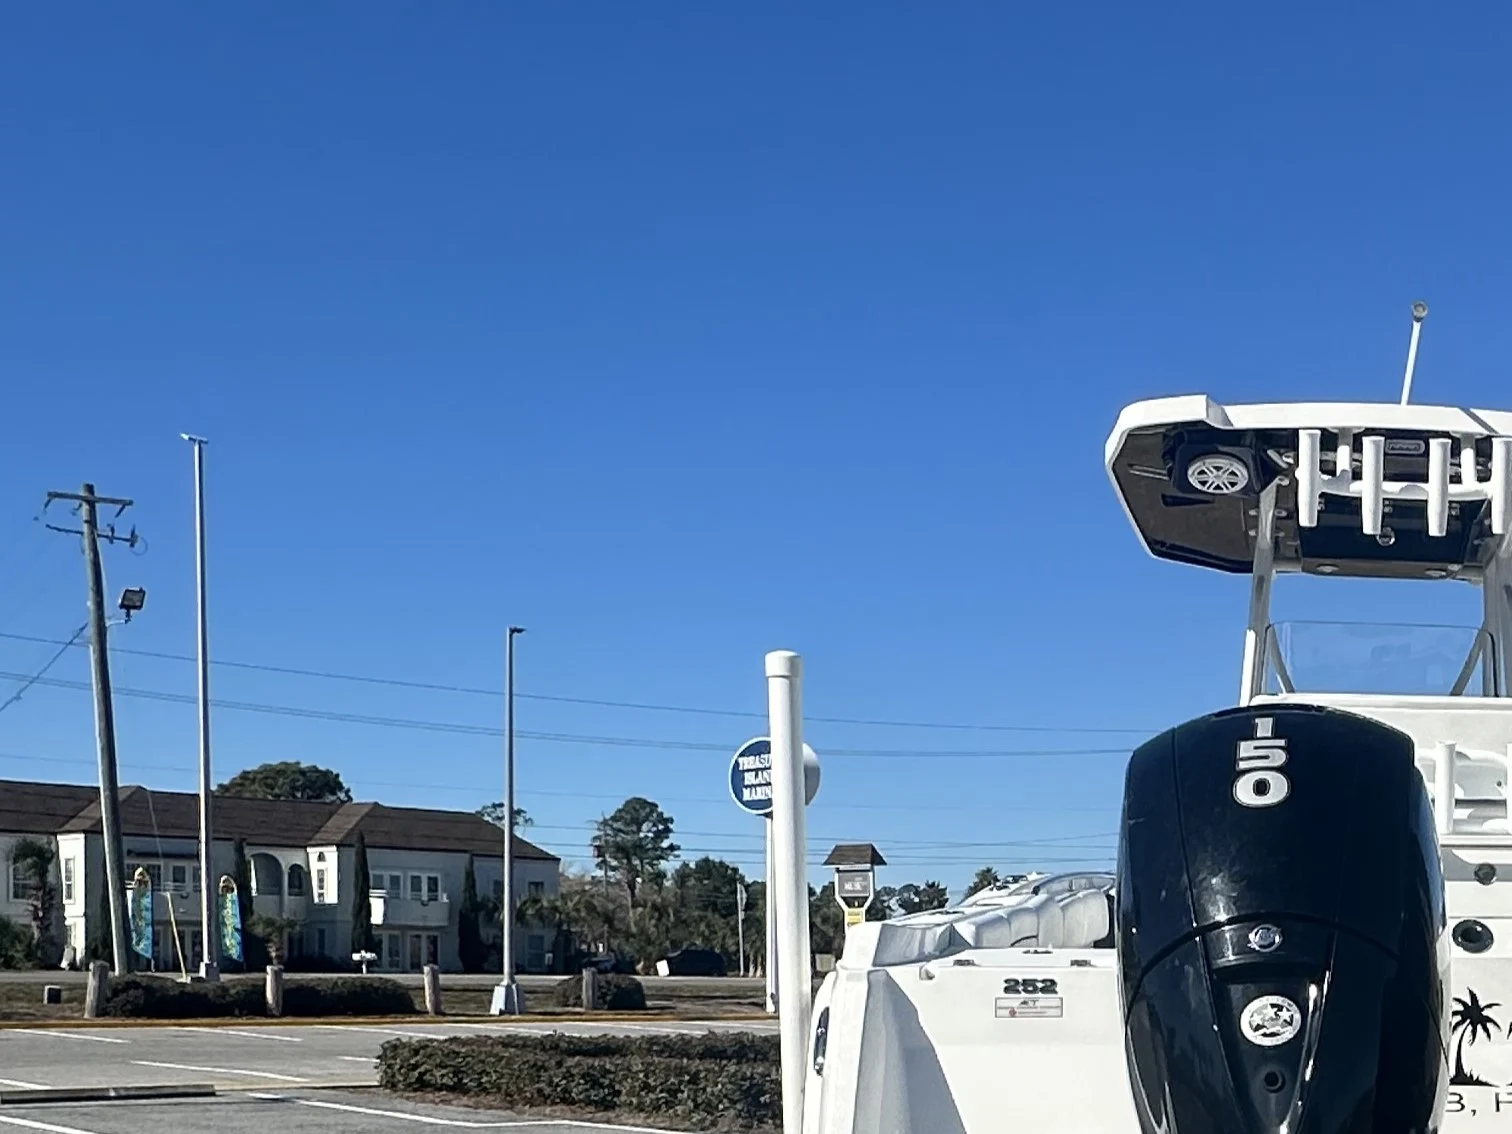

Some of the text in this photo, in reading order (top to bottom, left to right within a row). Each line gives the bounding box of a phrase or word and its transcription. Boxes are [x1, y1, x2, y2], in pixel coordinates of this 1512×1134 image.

[738, 754, 771, 770] TREASU
[1234, 717, 1290, 807] 150
[744, 770, 771, 785] ISLAN
[1003, 978, 1058, 995] 252
